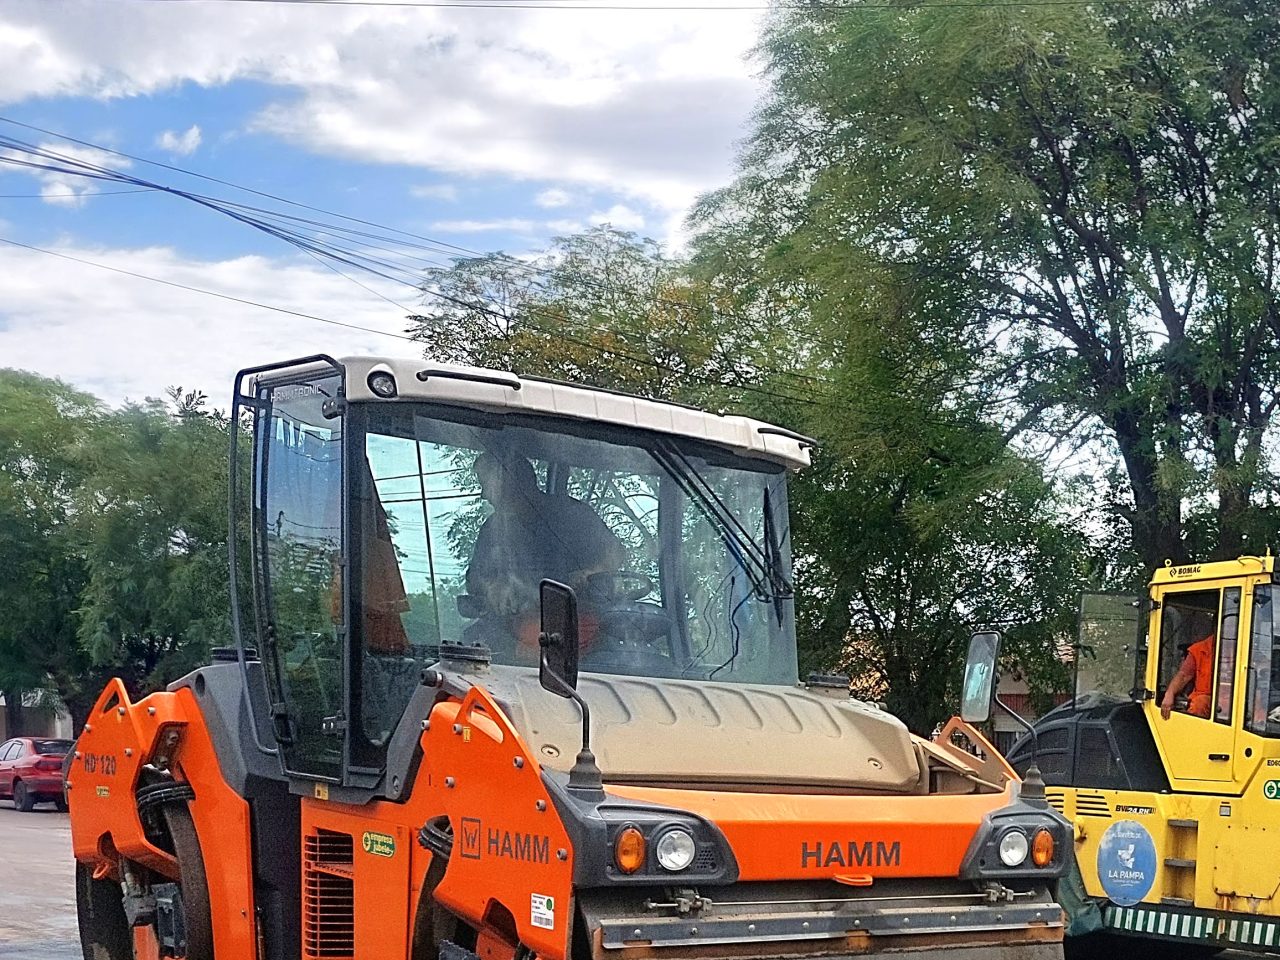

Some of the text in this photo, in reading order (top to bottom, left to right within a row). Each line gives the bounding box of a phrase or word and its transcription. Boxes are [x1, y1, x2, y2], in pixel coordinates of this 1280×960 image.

[100, 754, 116, 776] 120
[487, 827, 550, 865] HAMM
[801, 840, 901, 869] HAMM
[1108, 869, 1145, 881] LA PAMPA
